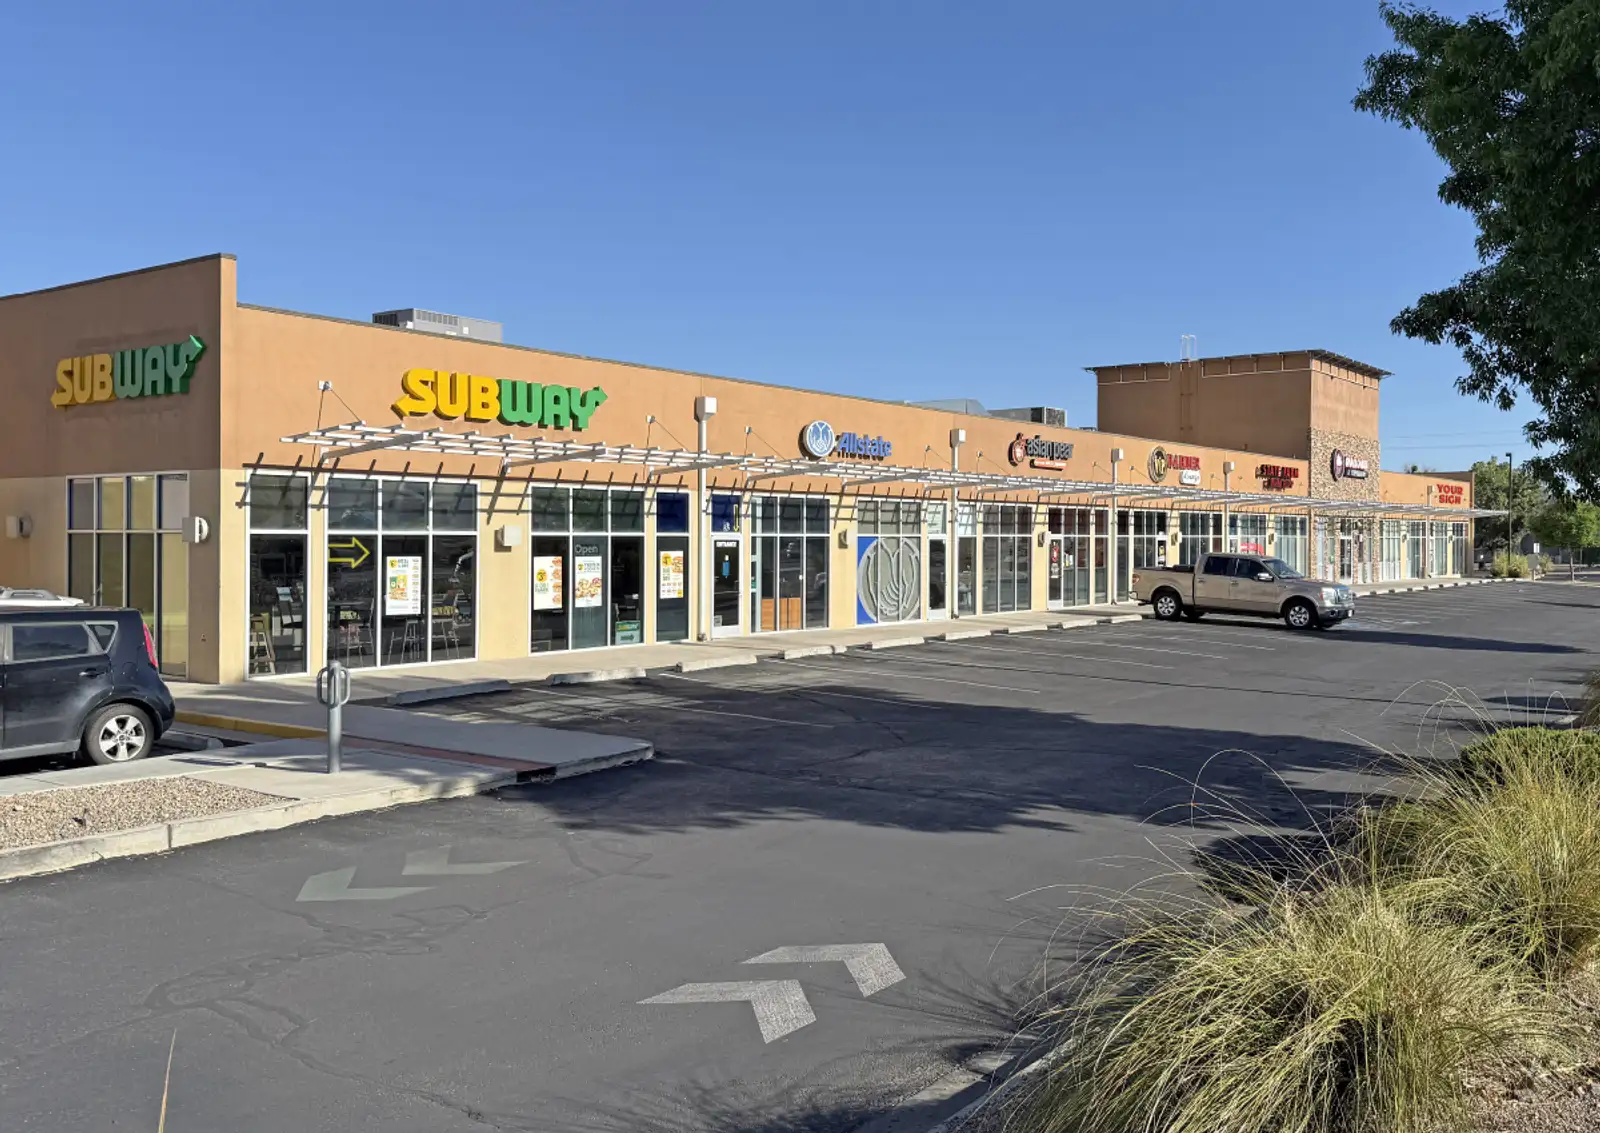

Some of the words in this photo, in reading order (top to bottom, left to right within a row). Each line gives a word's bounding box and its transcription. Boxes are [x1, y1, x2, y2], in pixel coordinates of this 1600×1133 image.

[50, 334, 206, 409] SUBWAY
[392, 367, 608, 431] SUBWAY
[838, 432, 892, 457] Allstate
[1027, 435, 1053, 460] asian
[1053, 442, 1073, 461] pear
[1437, 484, 1464, 495] YOUR
[1439, 494, 1462, 505] SIGN
[575, 544, 598, 555] Open
